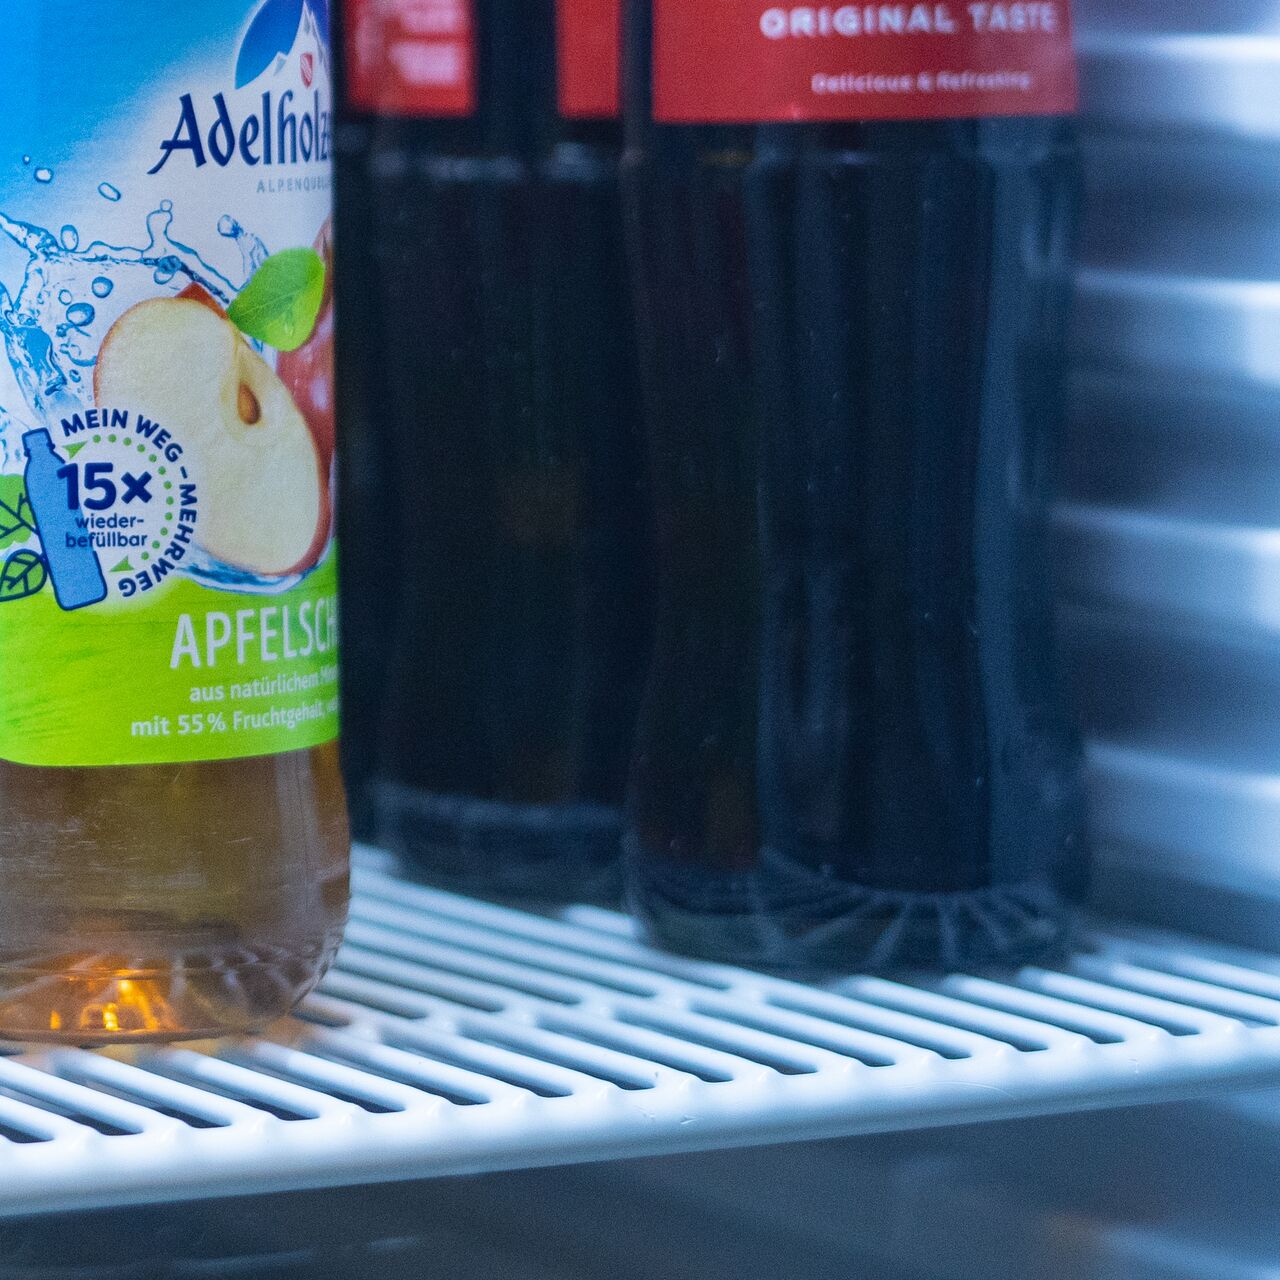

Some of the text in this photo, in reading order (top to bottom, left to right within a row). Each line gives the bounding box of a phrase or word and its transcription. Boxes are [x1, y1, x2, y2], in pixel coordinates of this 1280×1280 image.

[759, 1, 1057, 40] ORIGINAL TASTE
[146, 89, 332, 175] Adelholz
[60, 408, 184, 463] MEIN WEG
[74, 513, 144, 529] wieder-
[65, 531, 148, 548] befüllbar
[118, 483, 198, 598] MEHRWEG
[189, 684, 225, 702] aus
[131, 715, 170, 737] mit
